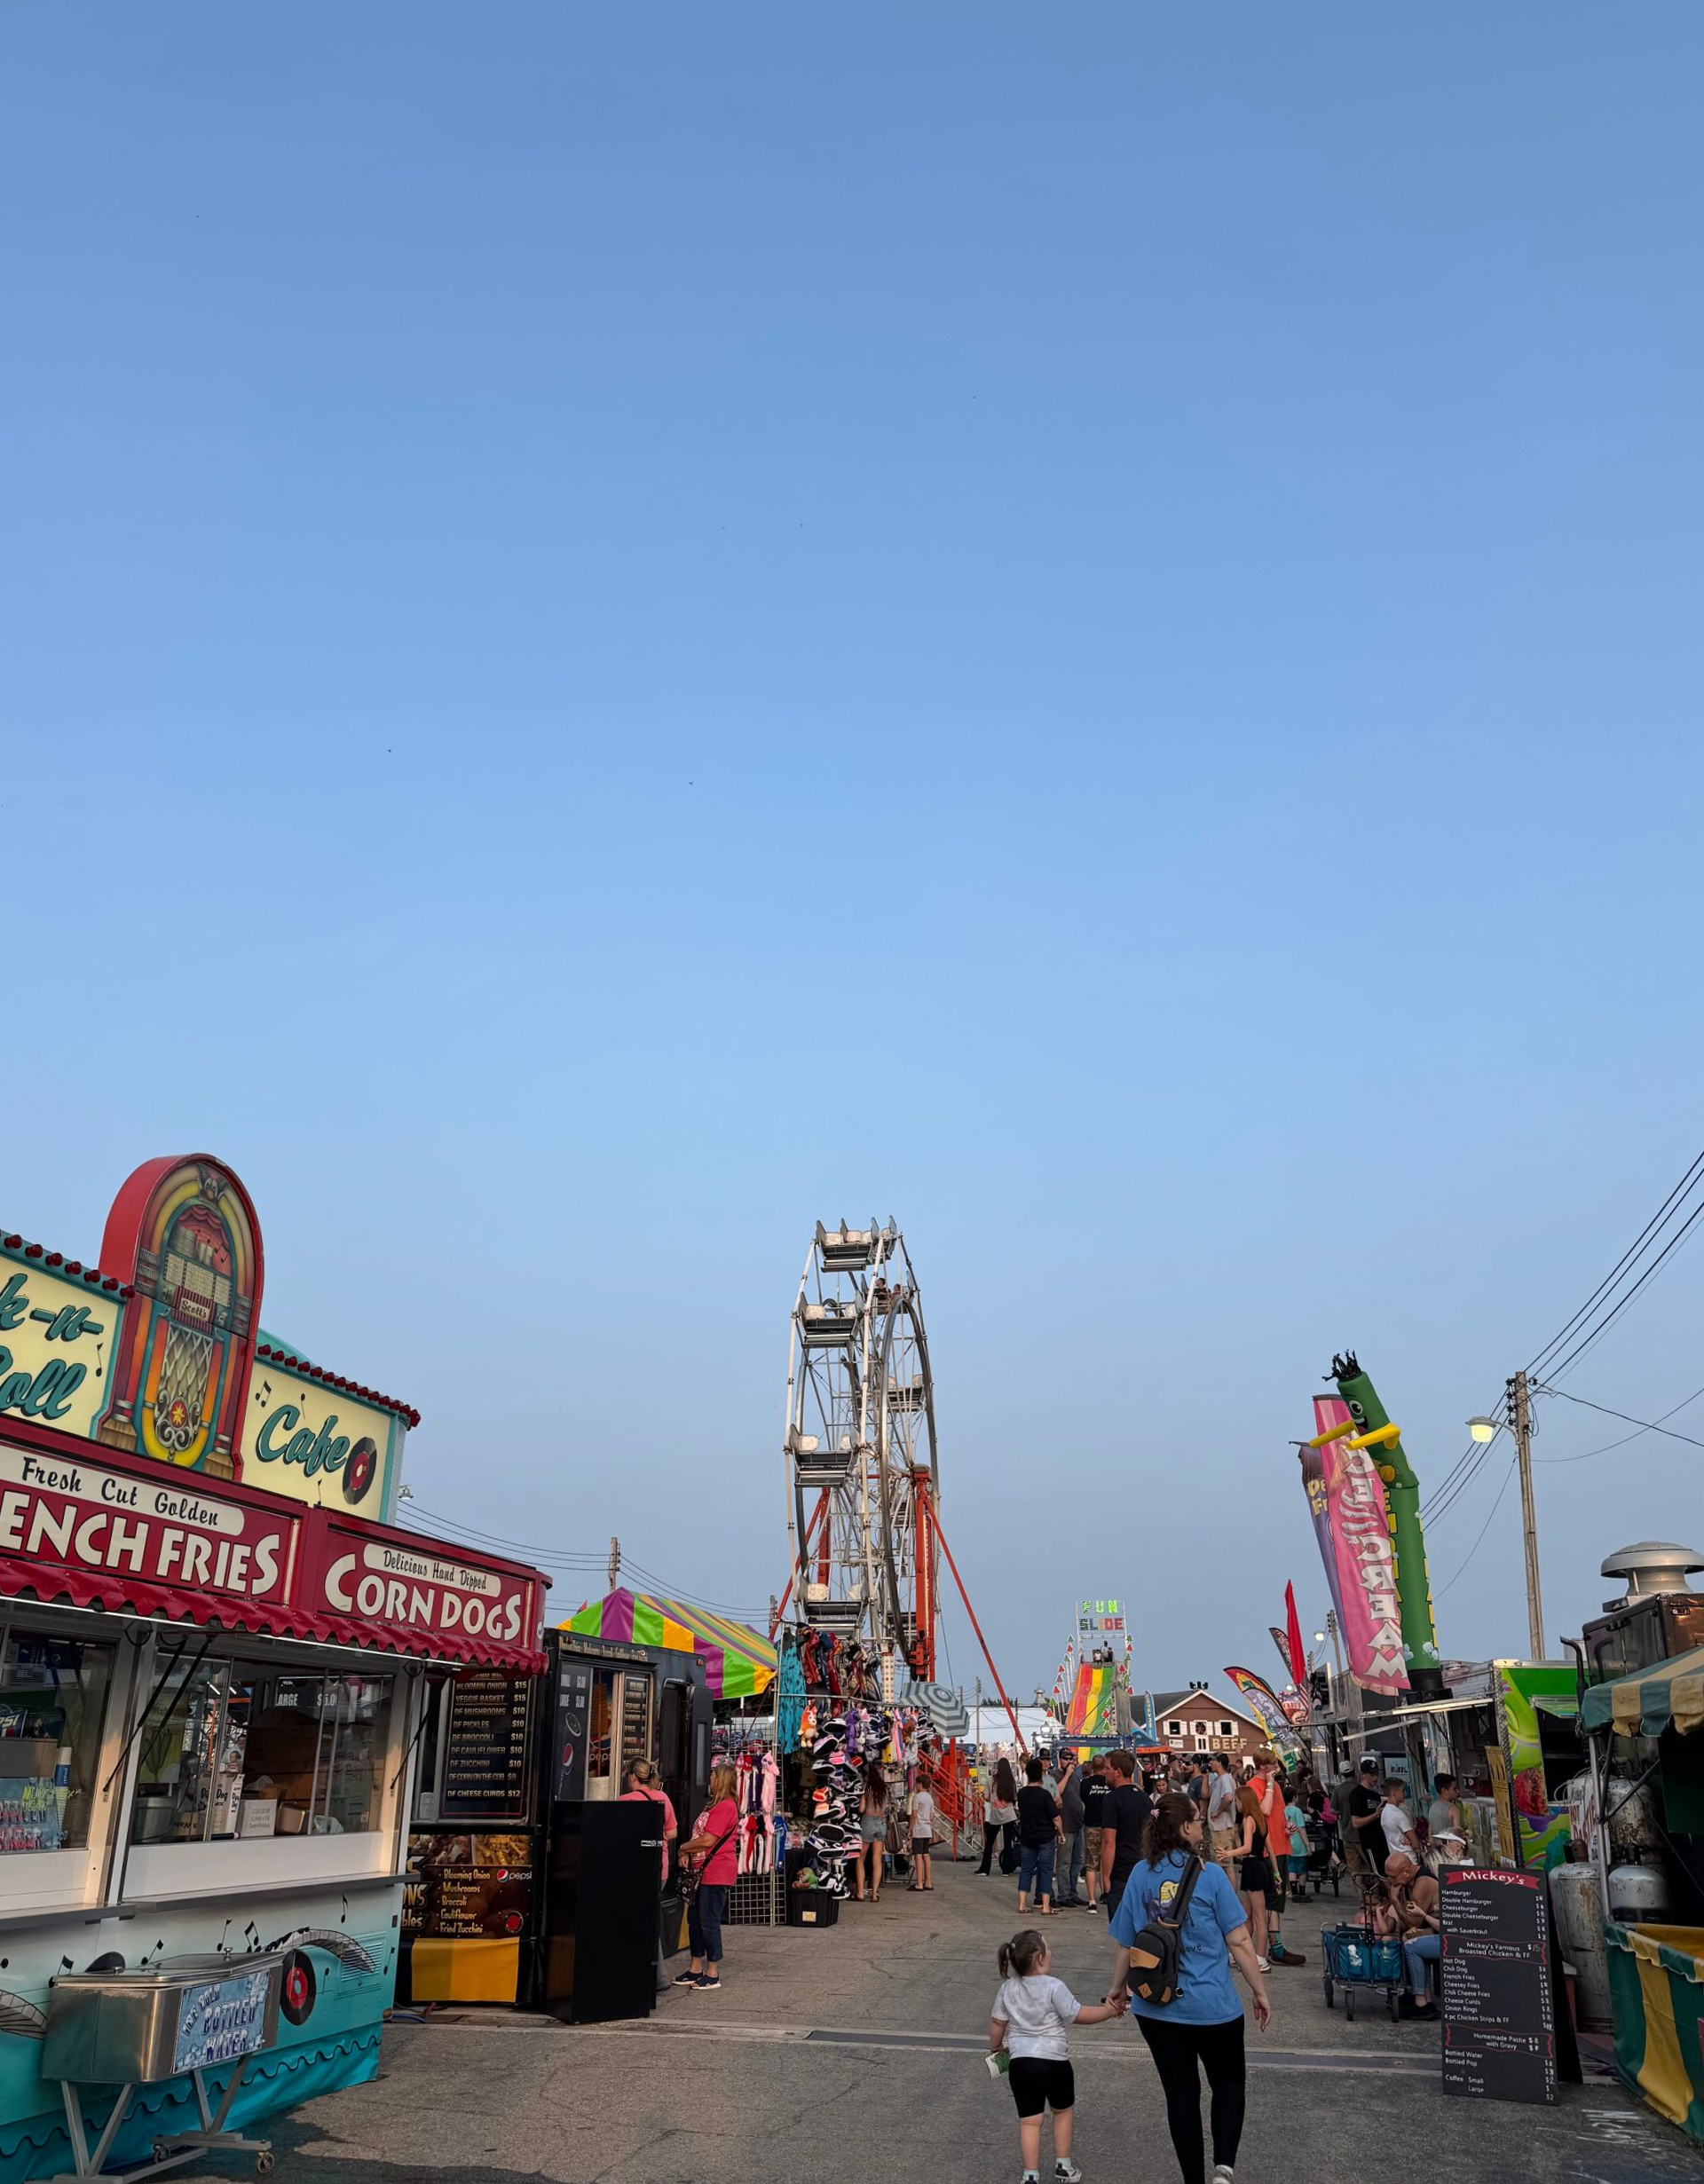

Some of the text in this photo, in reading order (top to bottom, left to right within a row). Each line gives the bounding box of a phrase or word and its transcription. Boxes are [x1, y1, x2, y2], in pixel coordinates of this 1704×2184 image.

[181, 1299, 207, 1319] Scott's
[256, 1404, 351, 1478] Cafe
[21, 1456, 218, 1526] Fresh Cut Golden
[156, 1527, 280, 1596] FRIES
[383, 1549, 487, 1591] Delicious Hand Dipped
[325, 1553, 521, 1642] CORN DOGS
[1082, 1599, 1118, 1614] FUN
[1079, 1617, 1124, 1631] SLIDE
[455, 1693, 526, 1703] VEGGIE BASKET $15
[509, 1746, 523, 1754] $10
[1212, 1738, 1247, 1750] BEEF
[444, 1868, 491, 1881] Blooming Onion
[509, 1871, 532, 1880] pepsi
[1462, 1871, 1525, 1886] Mickey's
[444, 1882, 480, 1893] Mushrooms
[442, 1895, 467, 1906] Broccoli
[440, 1908, 477, 1920] Cauliflower
[440, 1922, 483, 1934] Fried Zucchini
[1458, 1947, 1487, 1956] Broasted
[1466, 1942, 1494, 1952] Mickey's
[1527, 1944, 1541, 1952] $15
[202, 1995, 259, 2035] BOTTLED
[1473, 2032, 1508, 2042] Homemade
[1508, 2035, 1526, 2044] Pastie
[204, 2028, 248, 2062] WATER
[1500, 2042, 1518, 2051] Gravy
[1445, 2074, 1464, 2083] Coffee
